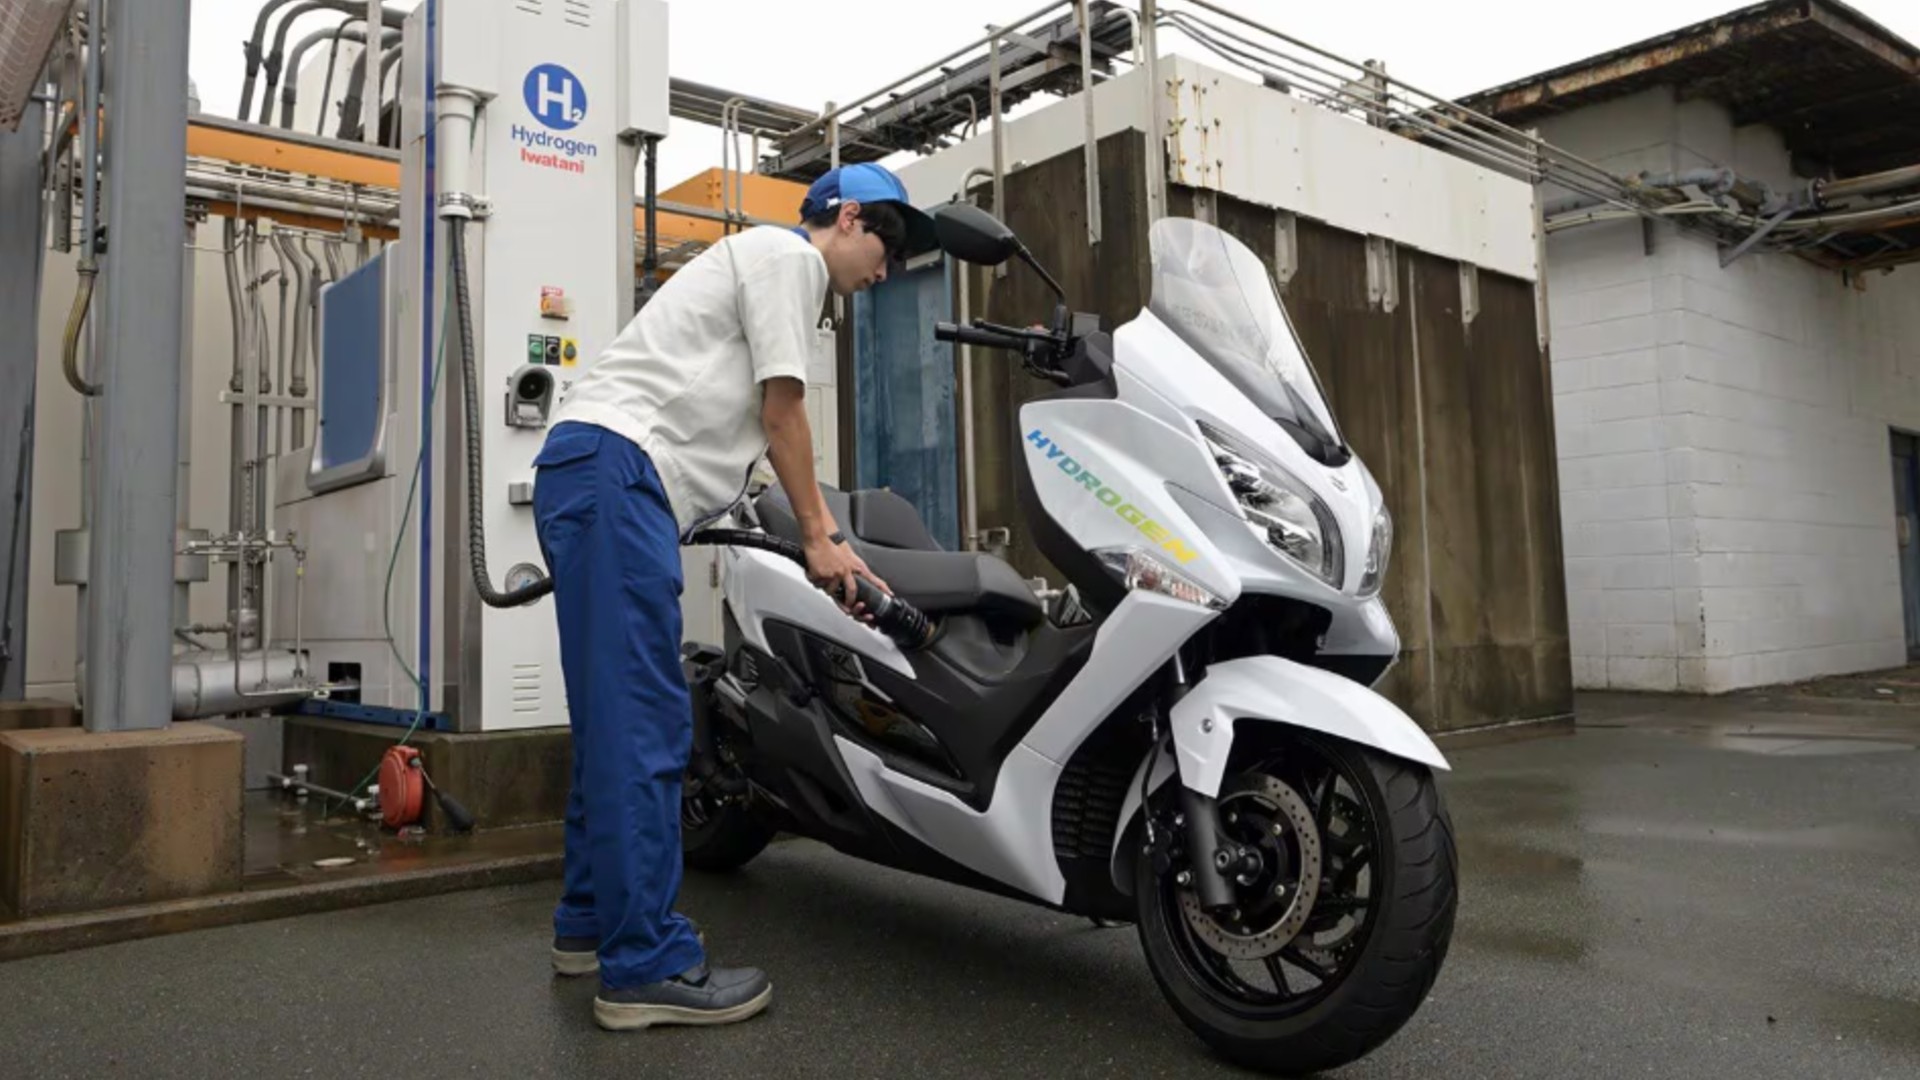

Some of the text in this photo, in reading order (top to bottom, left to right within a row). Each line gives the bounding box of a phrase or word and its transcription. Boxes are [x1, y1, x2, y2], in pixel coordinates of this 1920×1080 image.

[511, 124, 597, 157] Hydrogen
[521, 147, 584, 173] Iwatani
[1027, 429, 1198, 564] HYDROGEN
